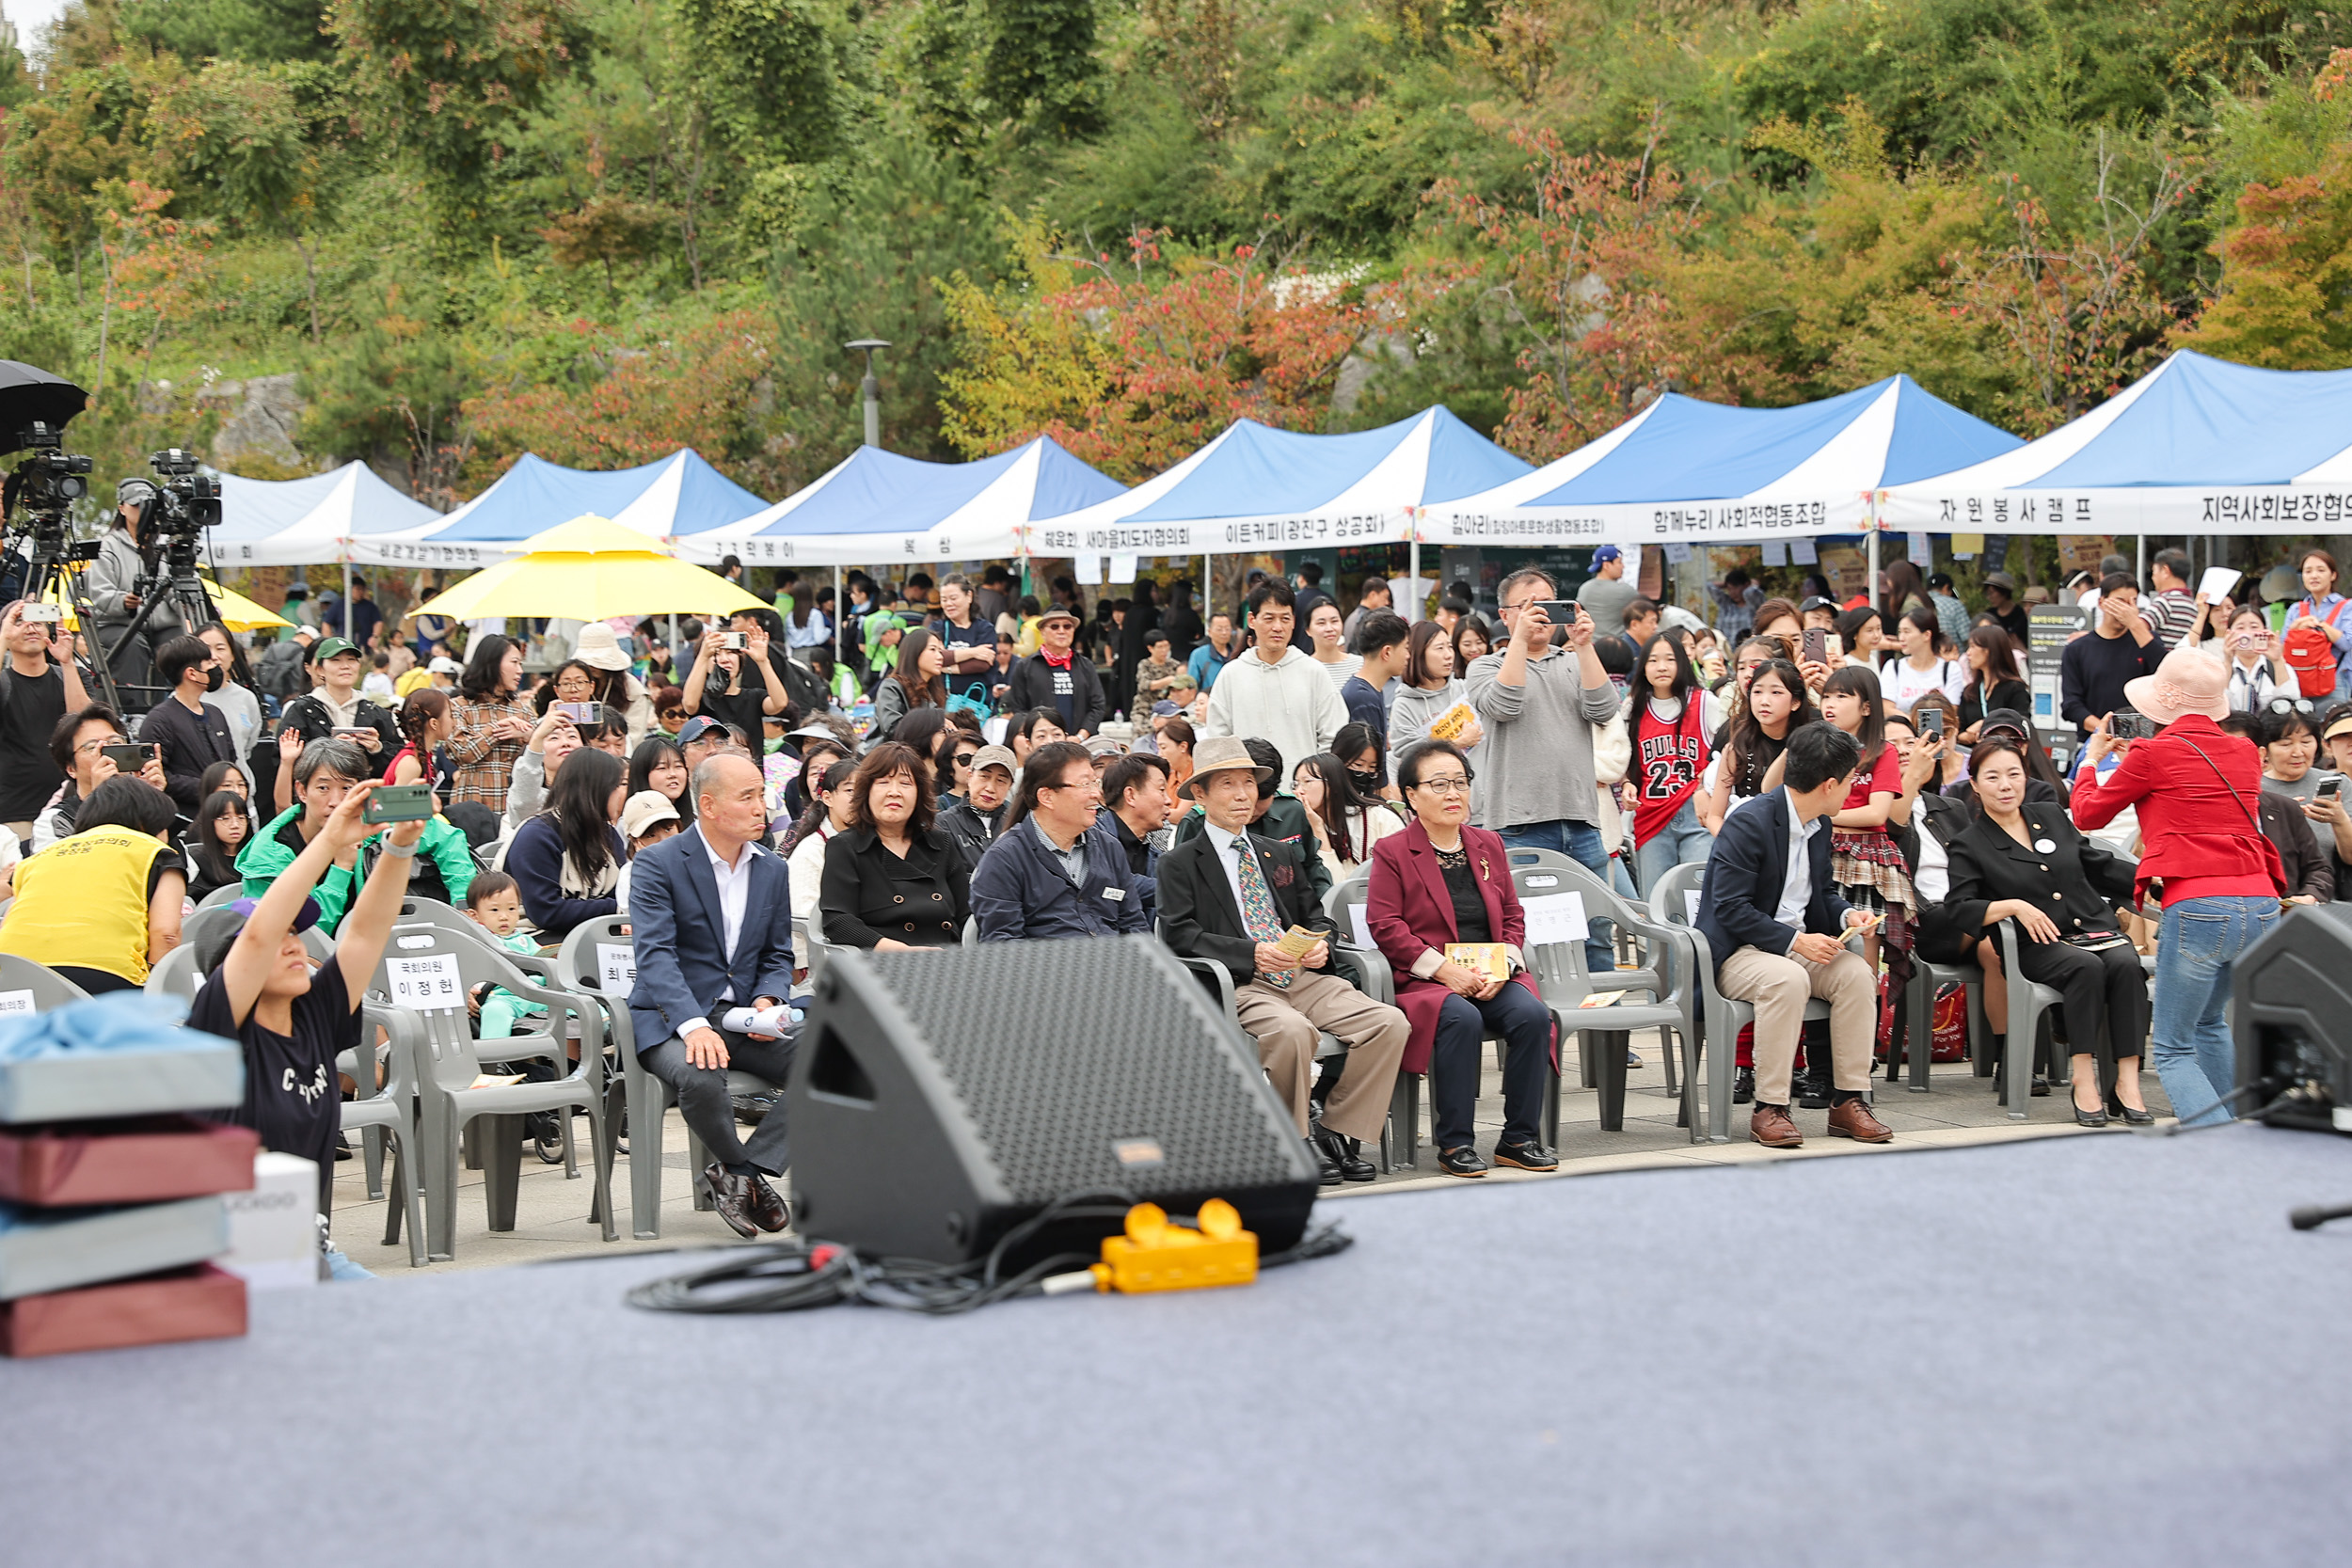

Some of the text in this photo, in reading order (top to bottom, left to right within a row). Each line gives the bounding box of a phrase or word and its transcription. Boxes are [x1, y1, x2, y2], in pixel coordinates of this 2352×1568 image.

[1336, 515, 1385, 537] 상공회)
[1654, 501, 1826, 532] 함께누리 사회적협동조합
[1086, 528, 1190, 549] 새마을지도자협의회
[1641, 735, 1699, 765] BULLS
[1645, 759, 1696, 800] 23
[401, 960, 443, 974] 국회의원
